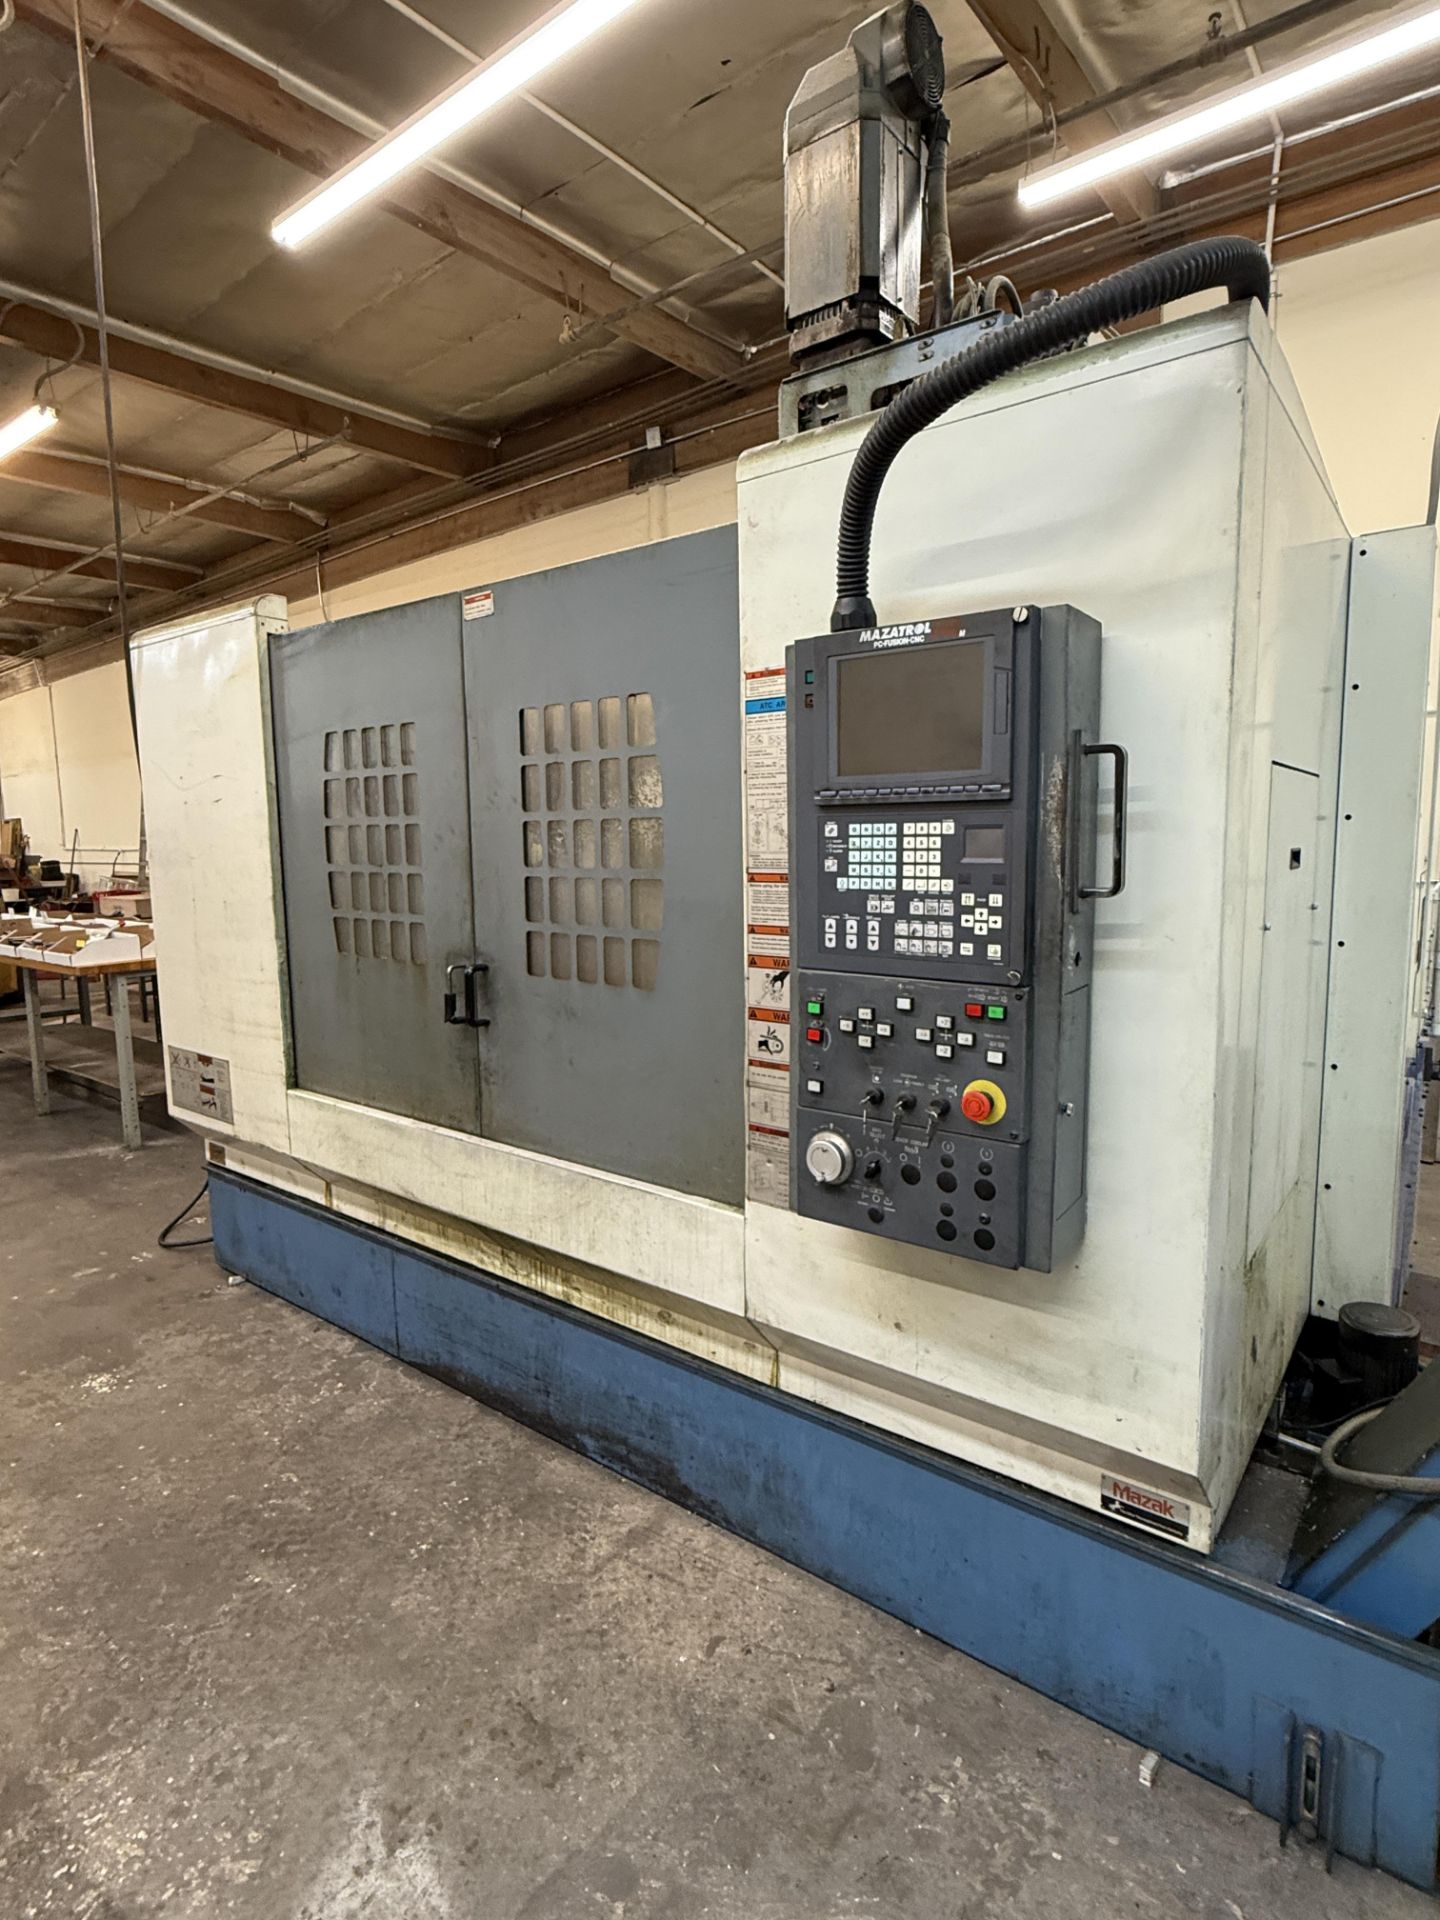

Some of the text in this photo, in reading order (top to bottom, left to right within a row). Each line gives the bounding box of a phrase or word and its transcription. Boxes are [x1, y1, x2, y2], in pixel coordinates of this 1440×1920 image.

[859, 622, 932, 642] MAZATROL
[760, 702, 773, 710] ATC
[1112, 1481, 1175, 1518] Mazak
